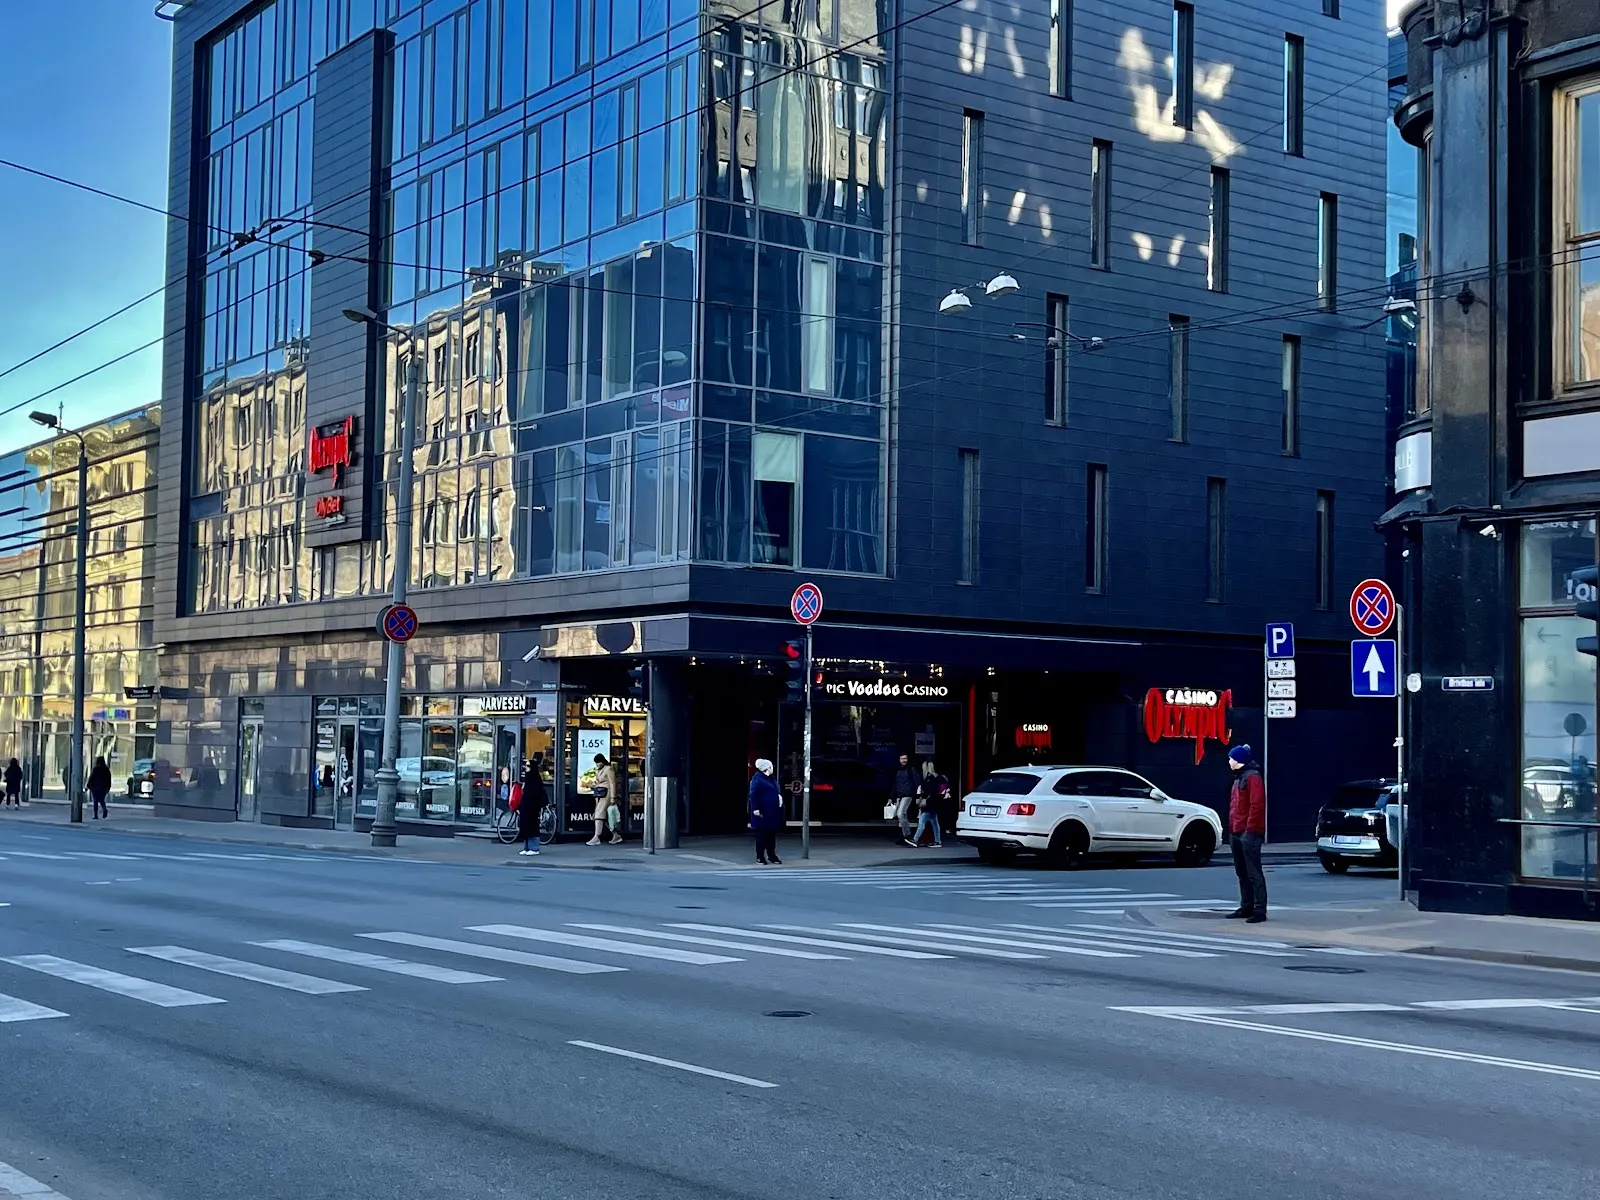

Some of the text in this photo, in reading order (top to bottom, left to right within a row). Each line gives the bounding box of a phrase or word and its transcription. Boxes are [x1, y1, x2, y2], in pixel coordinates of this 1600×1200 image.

[1273, 628, 1287, 653] P
[848, 679, 900, 696] Voodoo
[903, 684, 948, 696] CASINO
[479, 697, 526, 710] NARVESEN
[1166, 690, 1217, 706] CASINO
